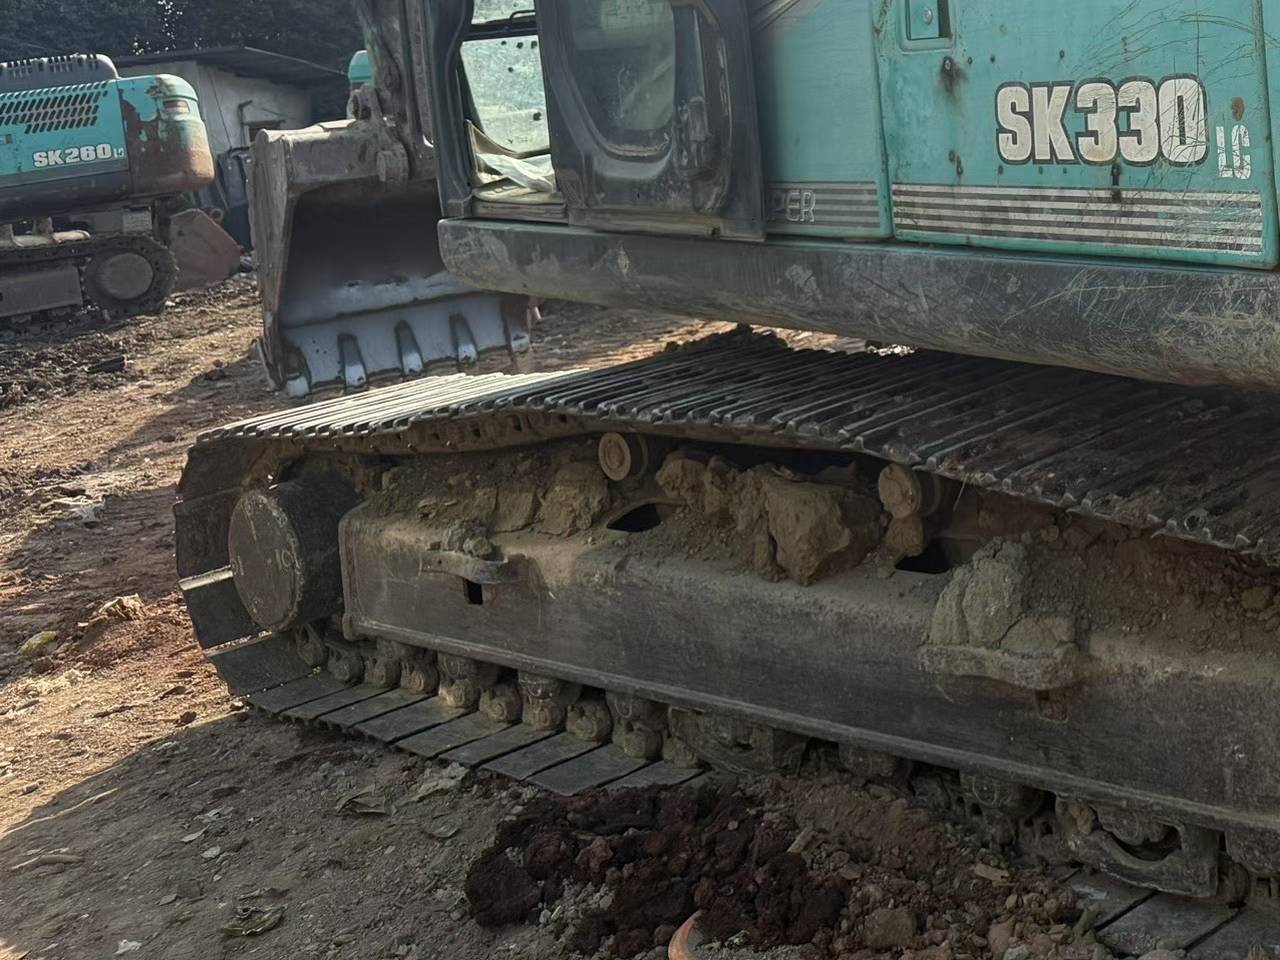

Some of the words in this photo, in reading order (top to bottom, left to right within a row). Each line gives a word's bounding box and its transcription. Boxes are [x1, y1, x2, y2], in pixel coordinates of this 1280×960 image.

[33, 143, 112, 168] SK260
[997, 74, 1208, 167] SK330
[1216, 124, 1252, 179] LC
